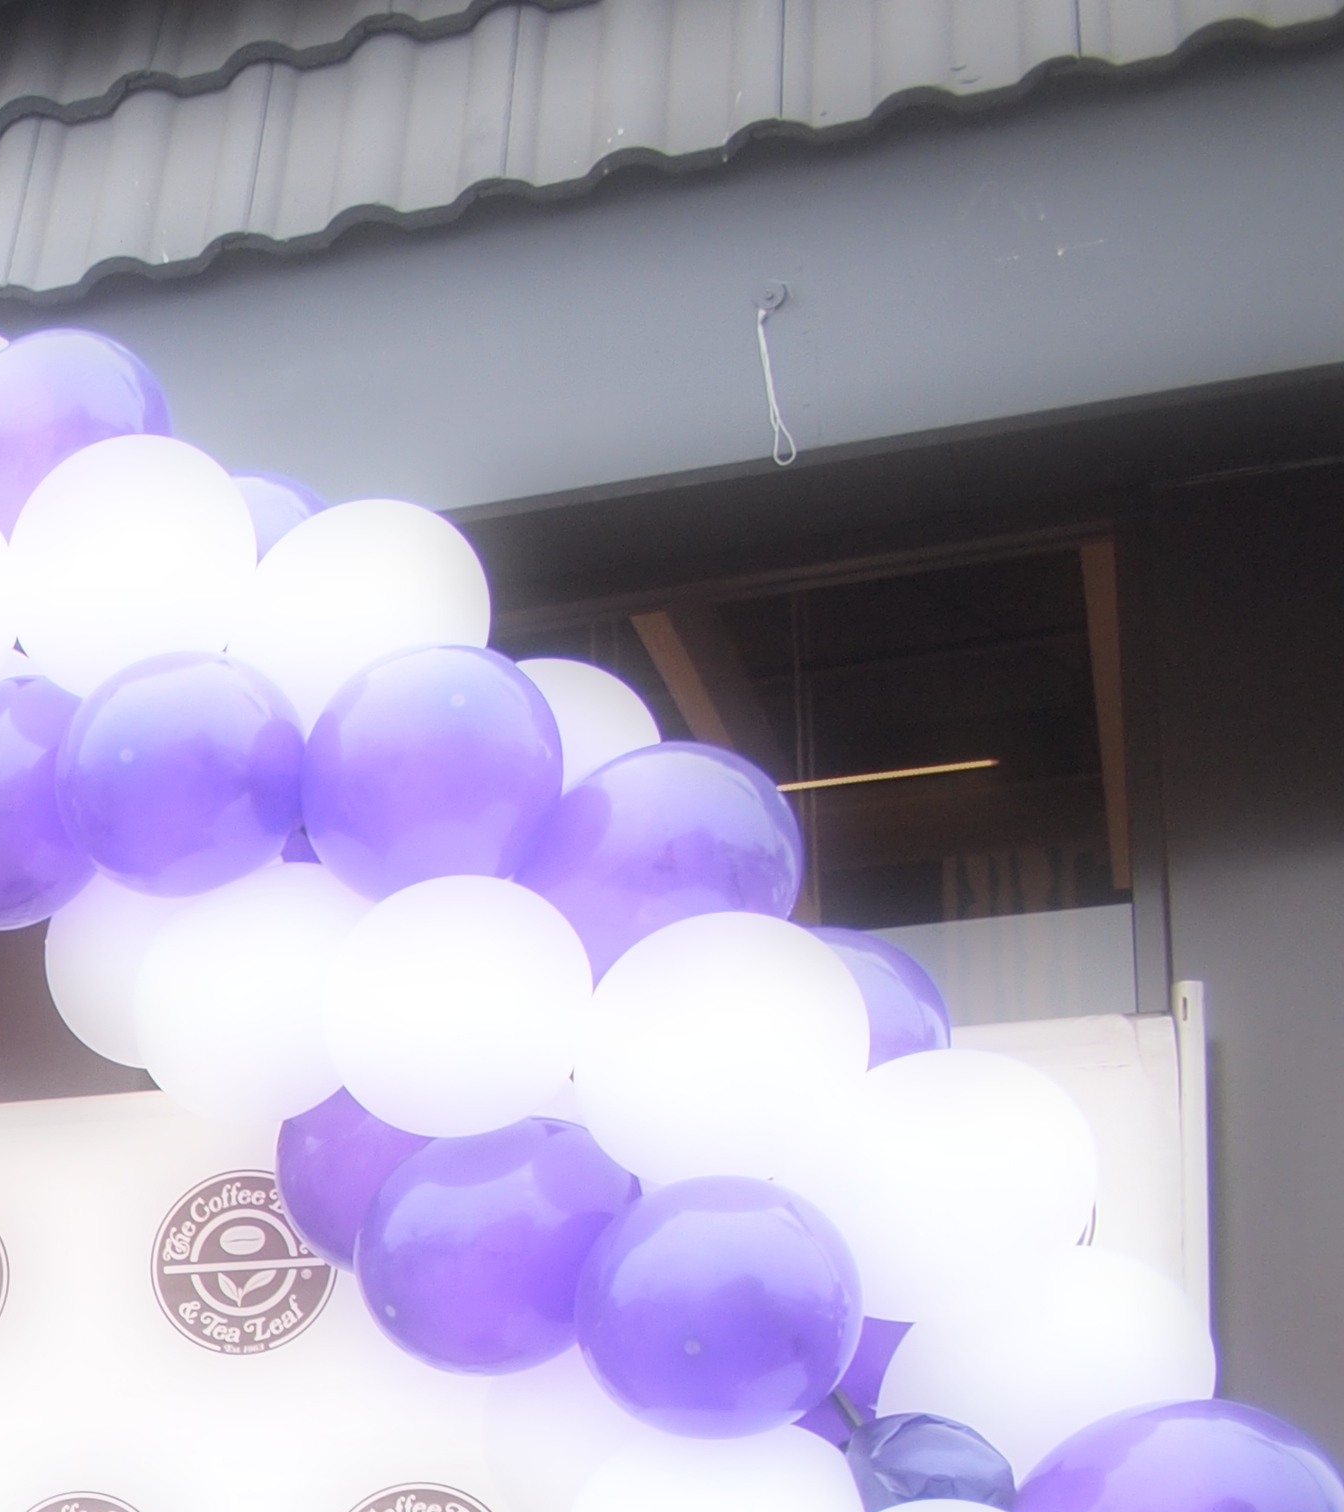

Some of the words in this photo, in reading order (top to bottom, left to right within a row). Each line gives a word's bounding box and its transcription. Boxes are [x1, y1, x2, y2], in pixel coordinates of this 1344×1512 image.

[162, 1220, 196, 1262] The
[190, 1181, 266, 1223] Coffee
[178, 1300, 201, 1325] &
[200, 1311, 241, 1343] Tea
[244, 1294, 304, 1342] Leaf
